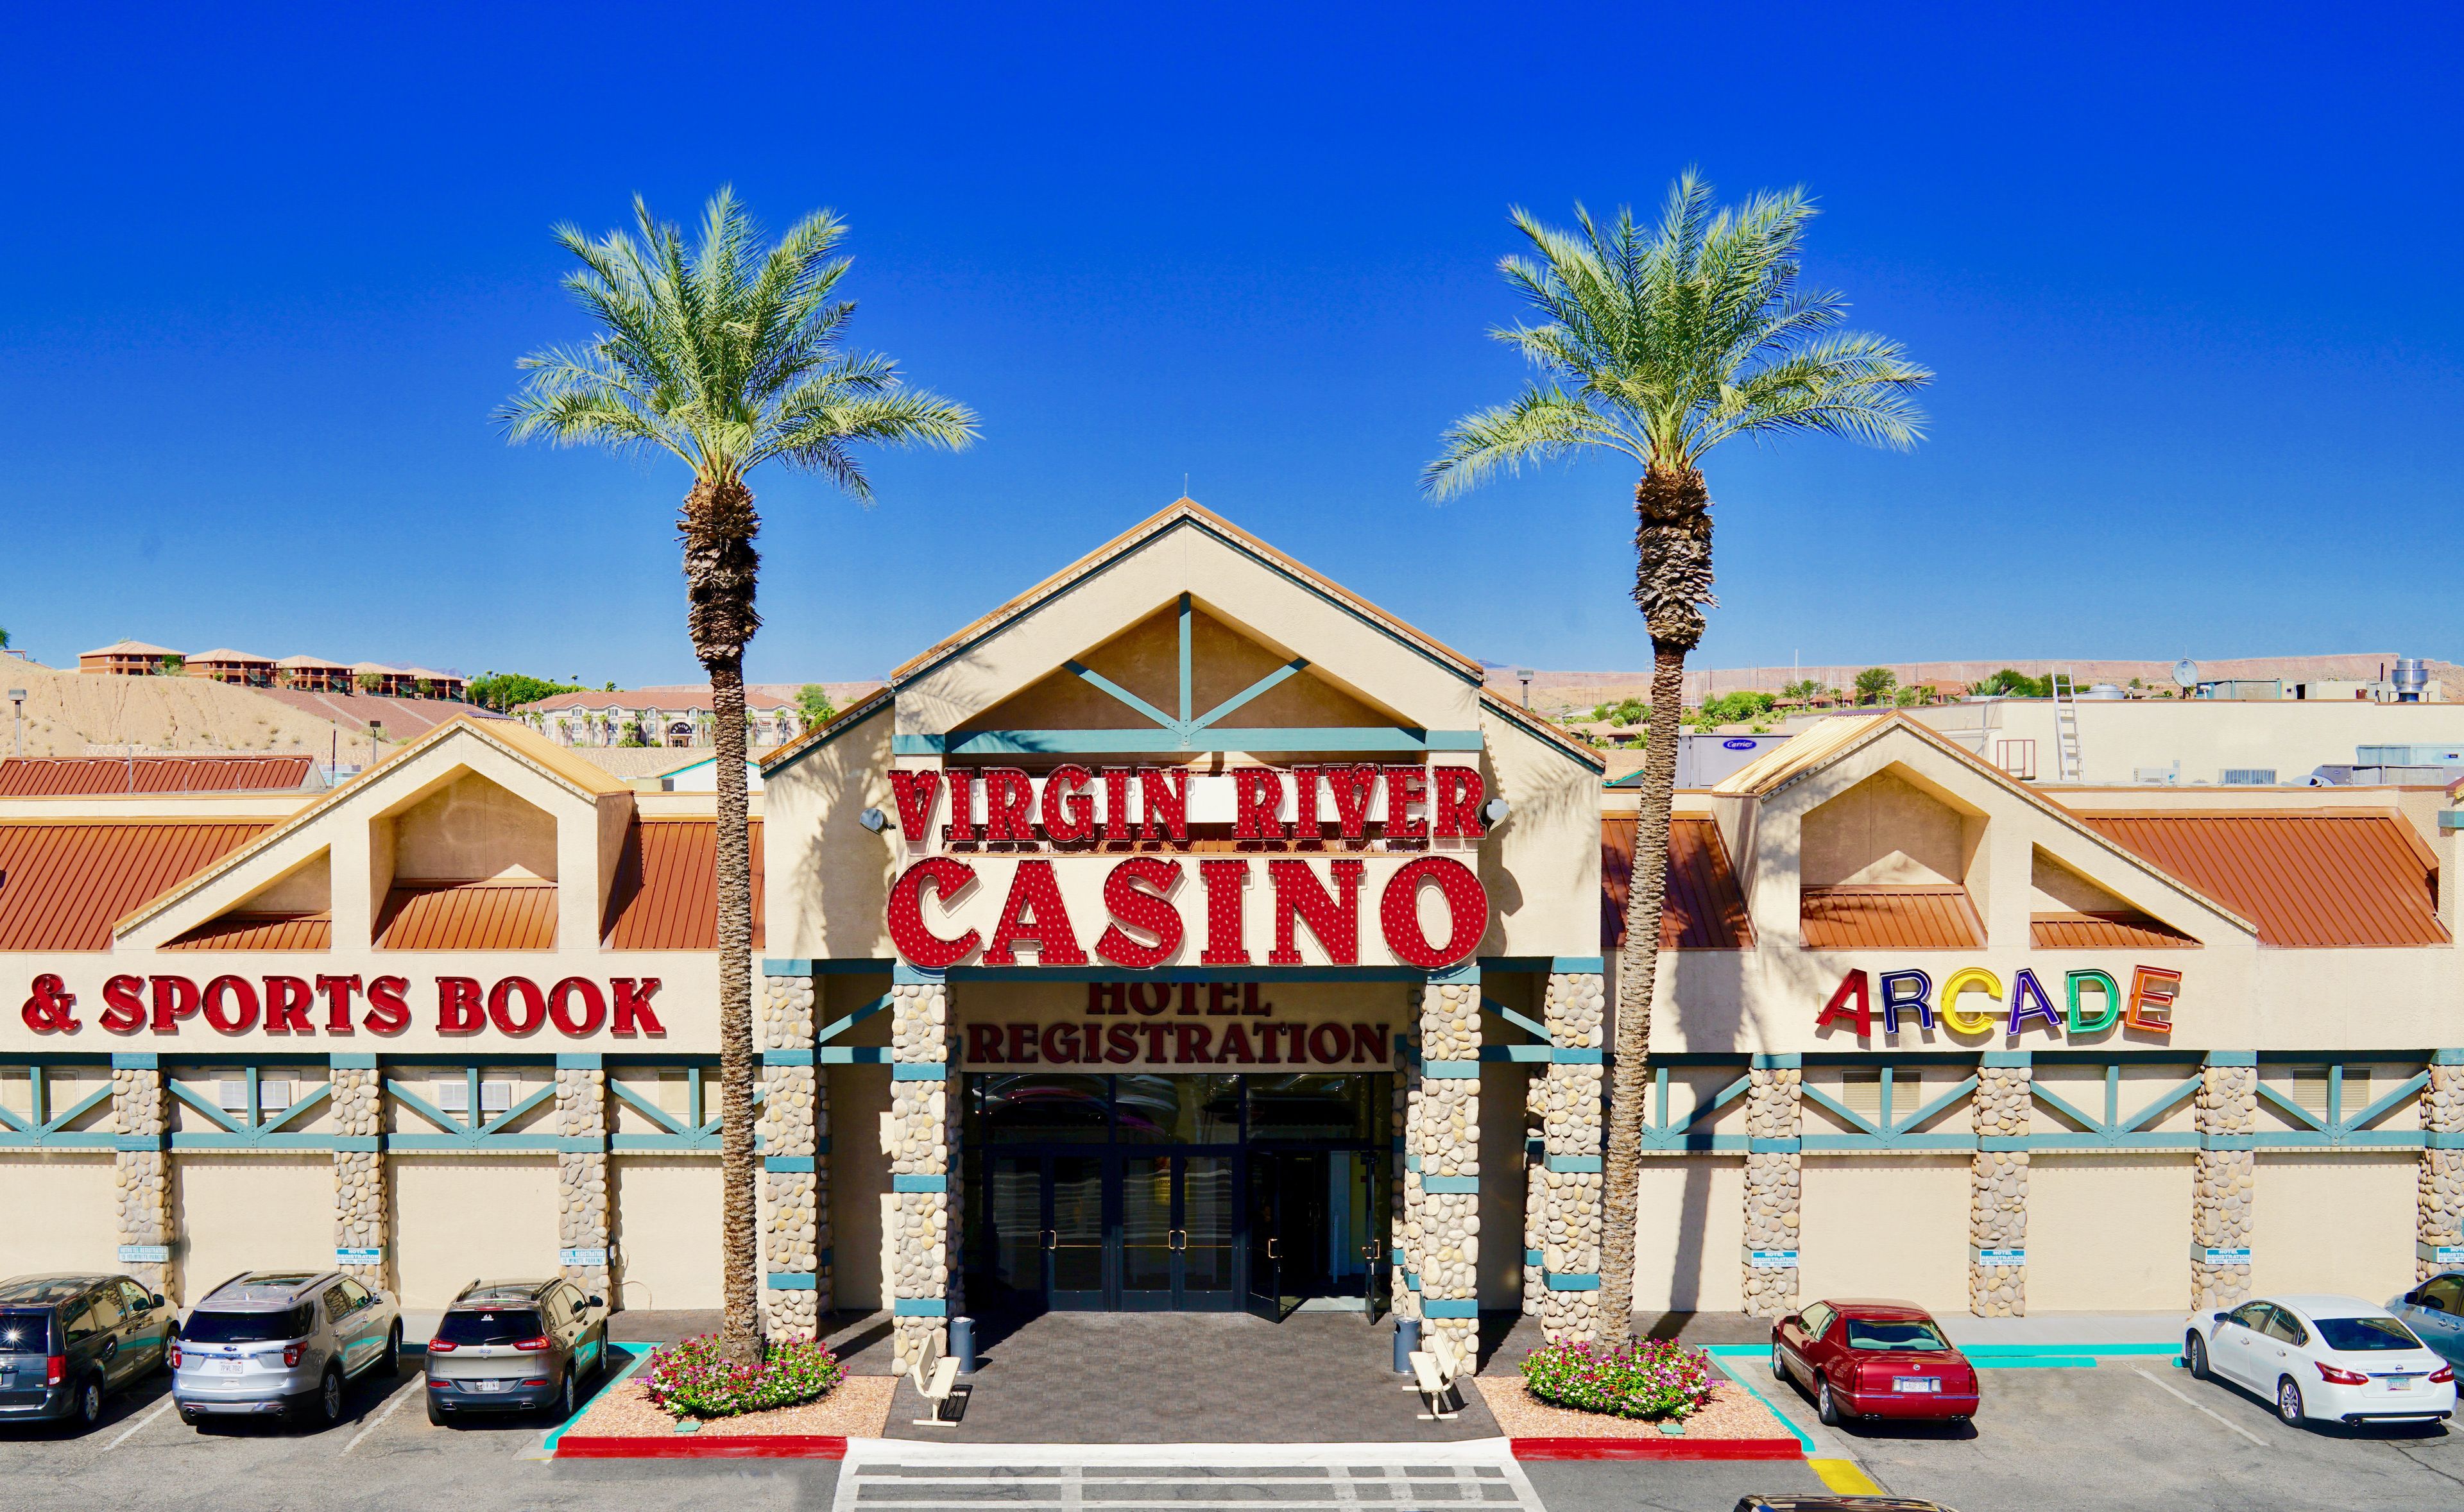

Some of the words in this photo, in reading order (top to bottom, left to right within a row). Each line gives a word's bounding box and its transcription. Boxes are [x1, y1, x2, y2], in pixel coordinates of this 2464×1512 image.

[672, 724, 690, 733] RESORT
[887, 764, 1189, 842] VIRGIN
[1232, 764, 1486, 841] RIVER
[887, 856, 1489, 970] CASINO
[21, 973, 81, 1031] &
[98, 973, 411, 1032] SPORTS
[435, 975, 666, 1035] BOOK
[1087, 982, 1271, 1016] HOTEL
[1815, 964, 2182, 1037] ARCADE
[966, 1024, 1391, 1065] REGISTRATION
